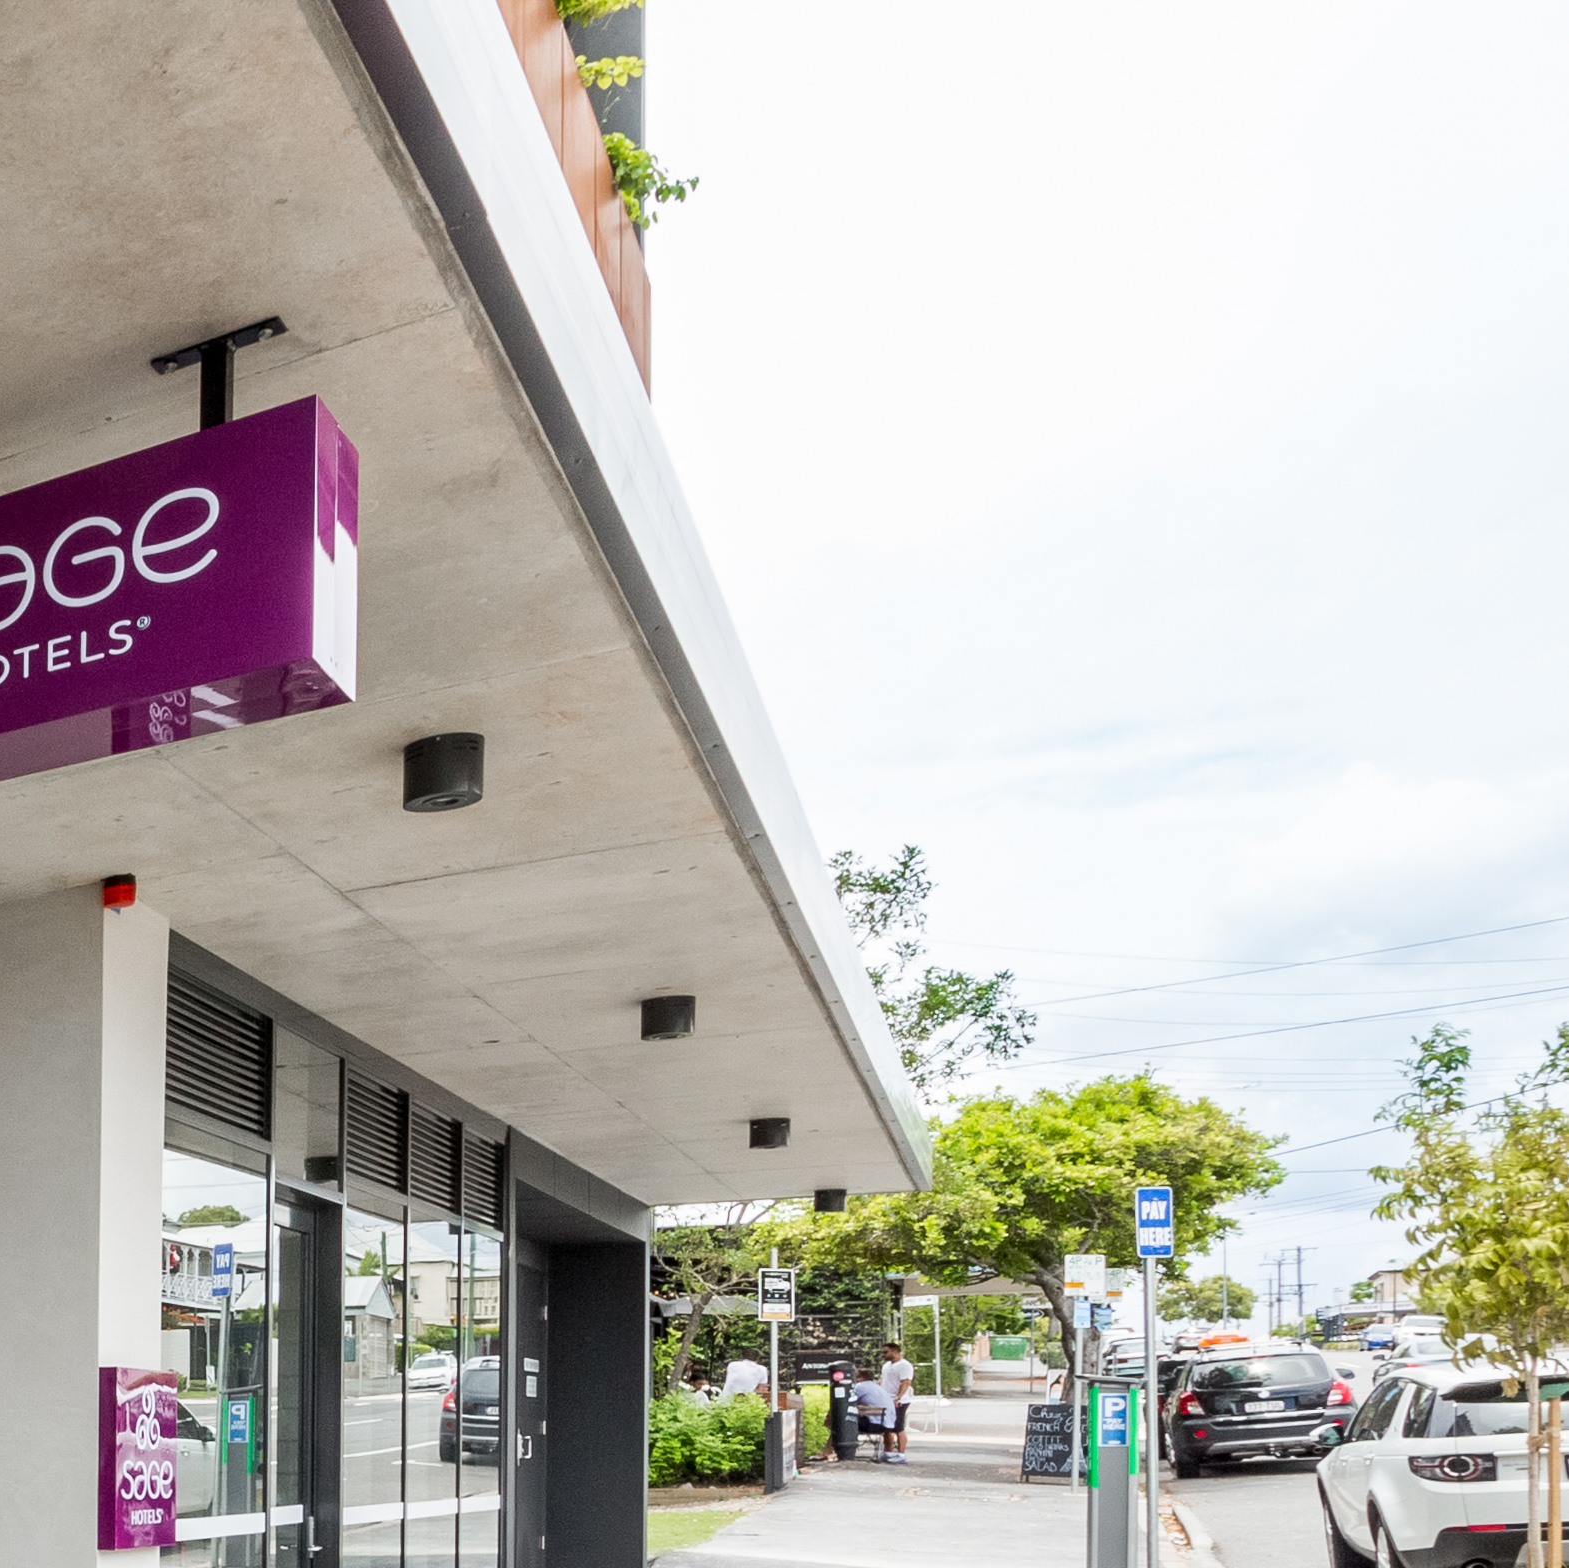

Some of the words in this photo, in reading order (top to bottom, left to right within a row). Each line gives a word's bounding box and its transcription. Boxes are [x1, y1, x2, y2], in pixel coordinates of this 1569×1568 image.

[1141, 1200, 1167, 1220] PAY
[1139, 1227, 1171, 1246] HERE
[1104, 1397, 1125, 1417] P
